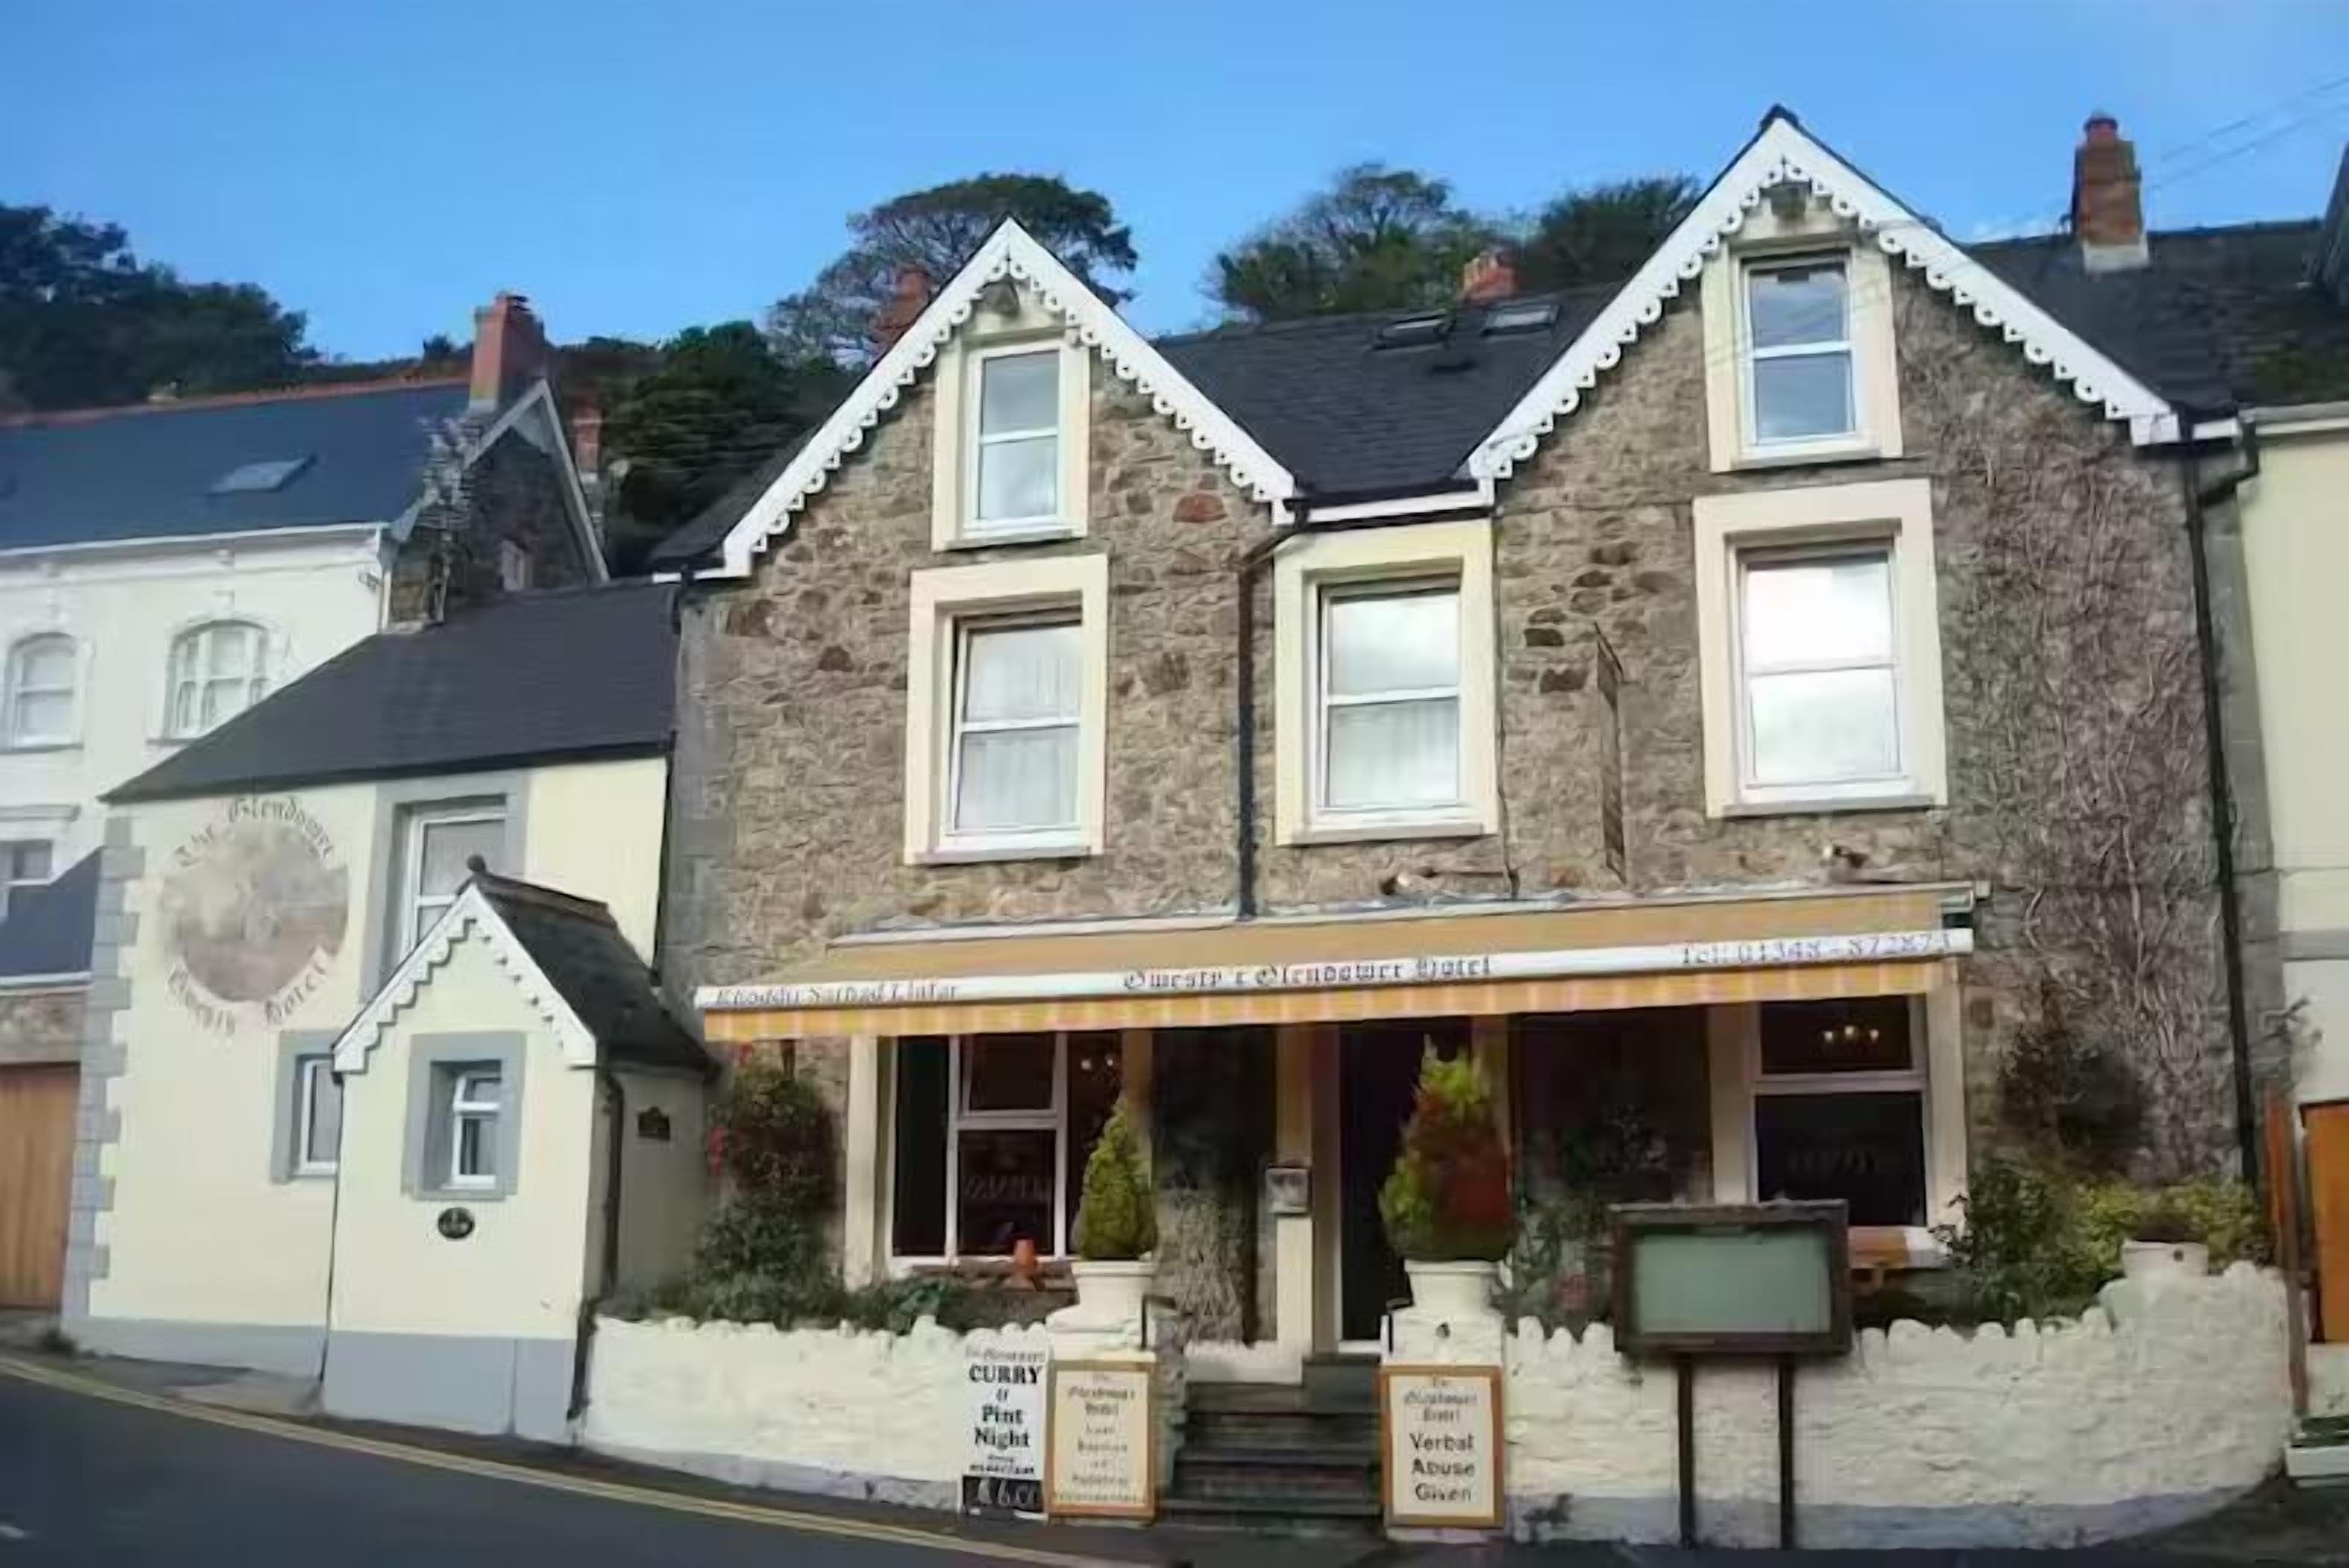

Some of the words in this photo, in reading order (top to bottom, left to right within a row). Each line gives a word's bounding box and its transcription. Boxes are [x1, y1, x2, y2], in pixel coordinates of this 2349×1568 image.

[969, 1364, 1042, 1384] CURRY
[982, 1404, 1024, 1424] Pint
[974, 1426, 1030, 1451] Night
[1409, 1431, 1475, 1451] Verbal
[1411, 1457, 1475, 1477] Abuse
[1414, 1481, 1472, 1501] Given
